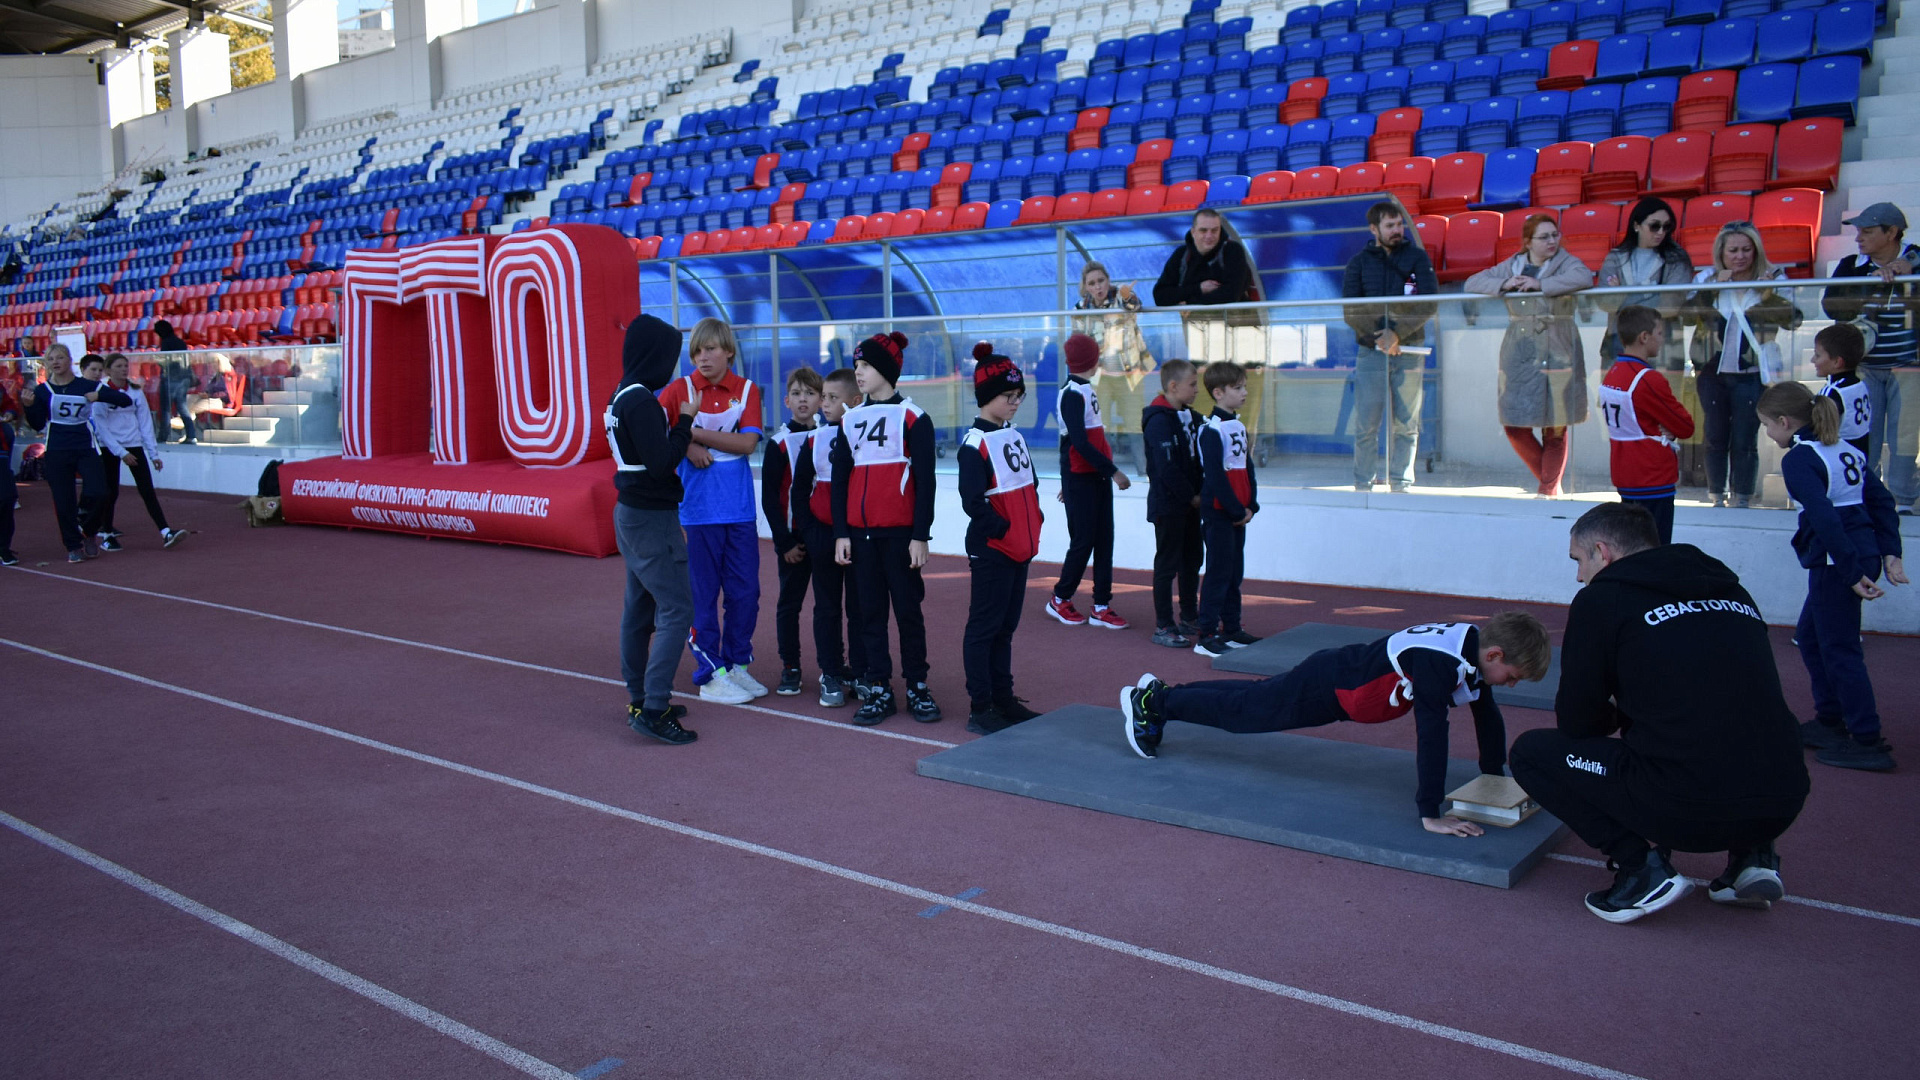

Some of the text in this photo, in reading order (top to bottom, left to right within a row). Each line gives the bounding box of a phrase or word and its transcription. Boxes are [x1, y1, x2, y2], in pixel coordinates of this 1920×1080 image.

[341, 227, 592, 470] ГТО
[59, 401, 86, 418] 57
[1854, 393, 1871, 425] 83
[854, 416, 888, 448] 74
[1002, 438, 1030, 473] 65
[292, 478, 550, 518] ВСЕРОССИЙСКИЙ ФИЗКУЛЬТУРНО-СПОРТИВНЫЙ КОМПЛЕКС
[381, 509, 393, 524] К
[389, 509, 420, 529] ТРУДУ
[418, 512, 429, 529] И
